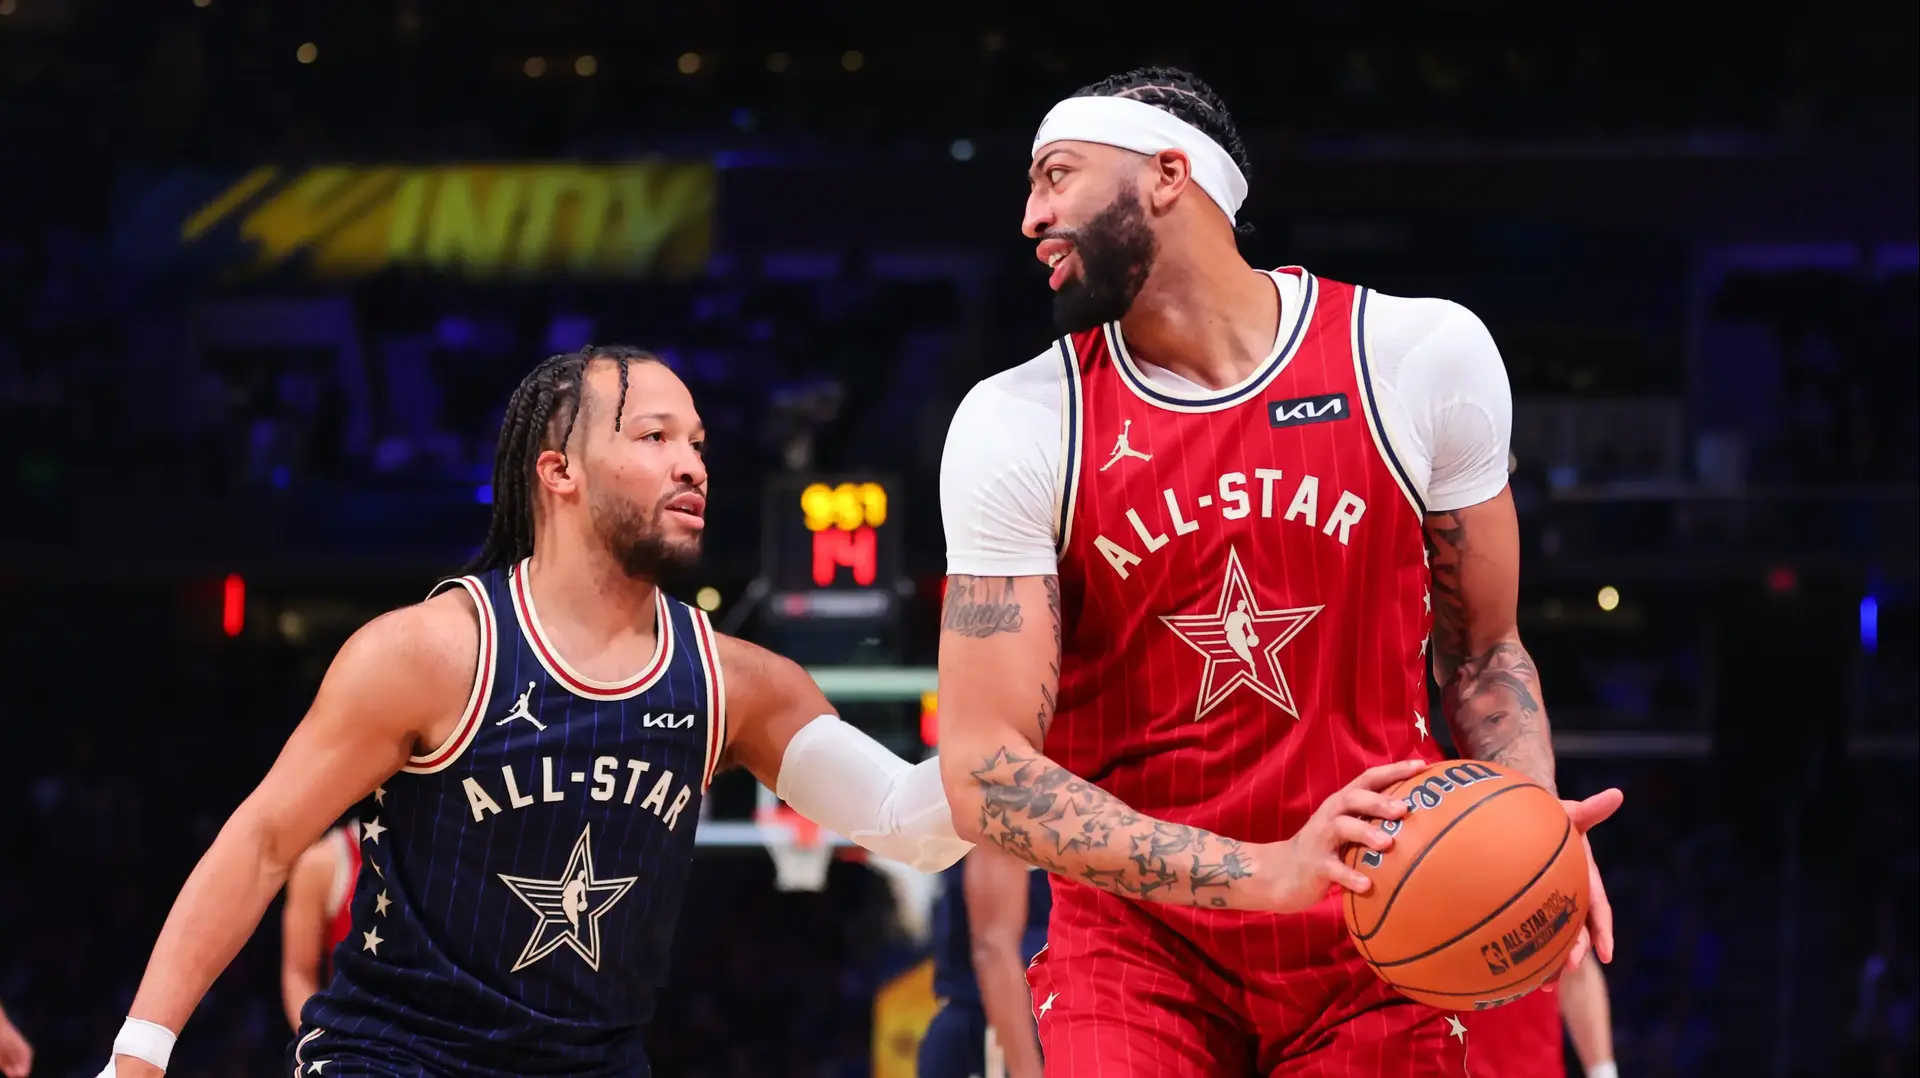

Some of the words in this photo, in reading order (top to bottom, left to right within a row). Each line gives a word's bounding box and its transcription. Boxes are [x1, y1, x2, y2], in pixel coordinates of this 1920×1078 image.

[1275, 398, 1342, 422] KIA
[1093, 468, 1367, 580] ALL-STAR
[643, 712, 694, 729] KIA
[462, 756, 691, 832] ALL-STAR
